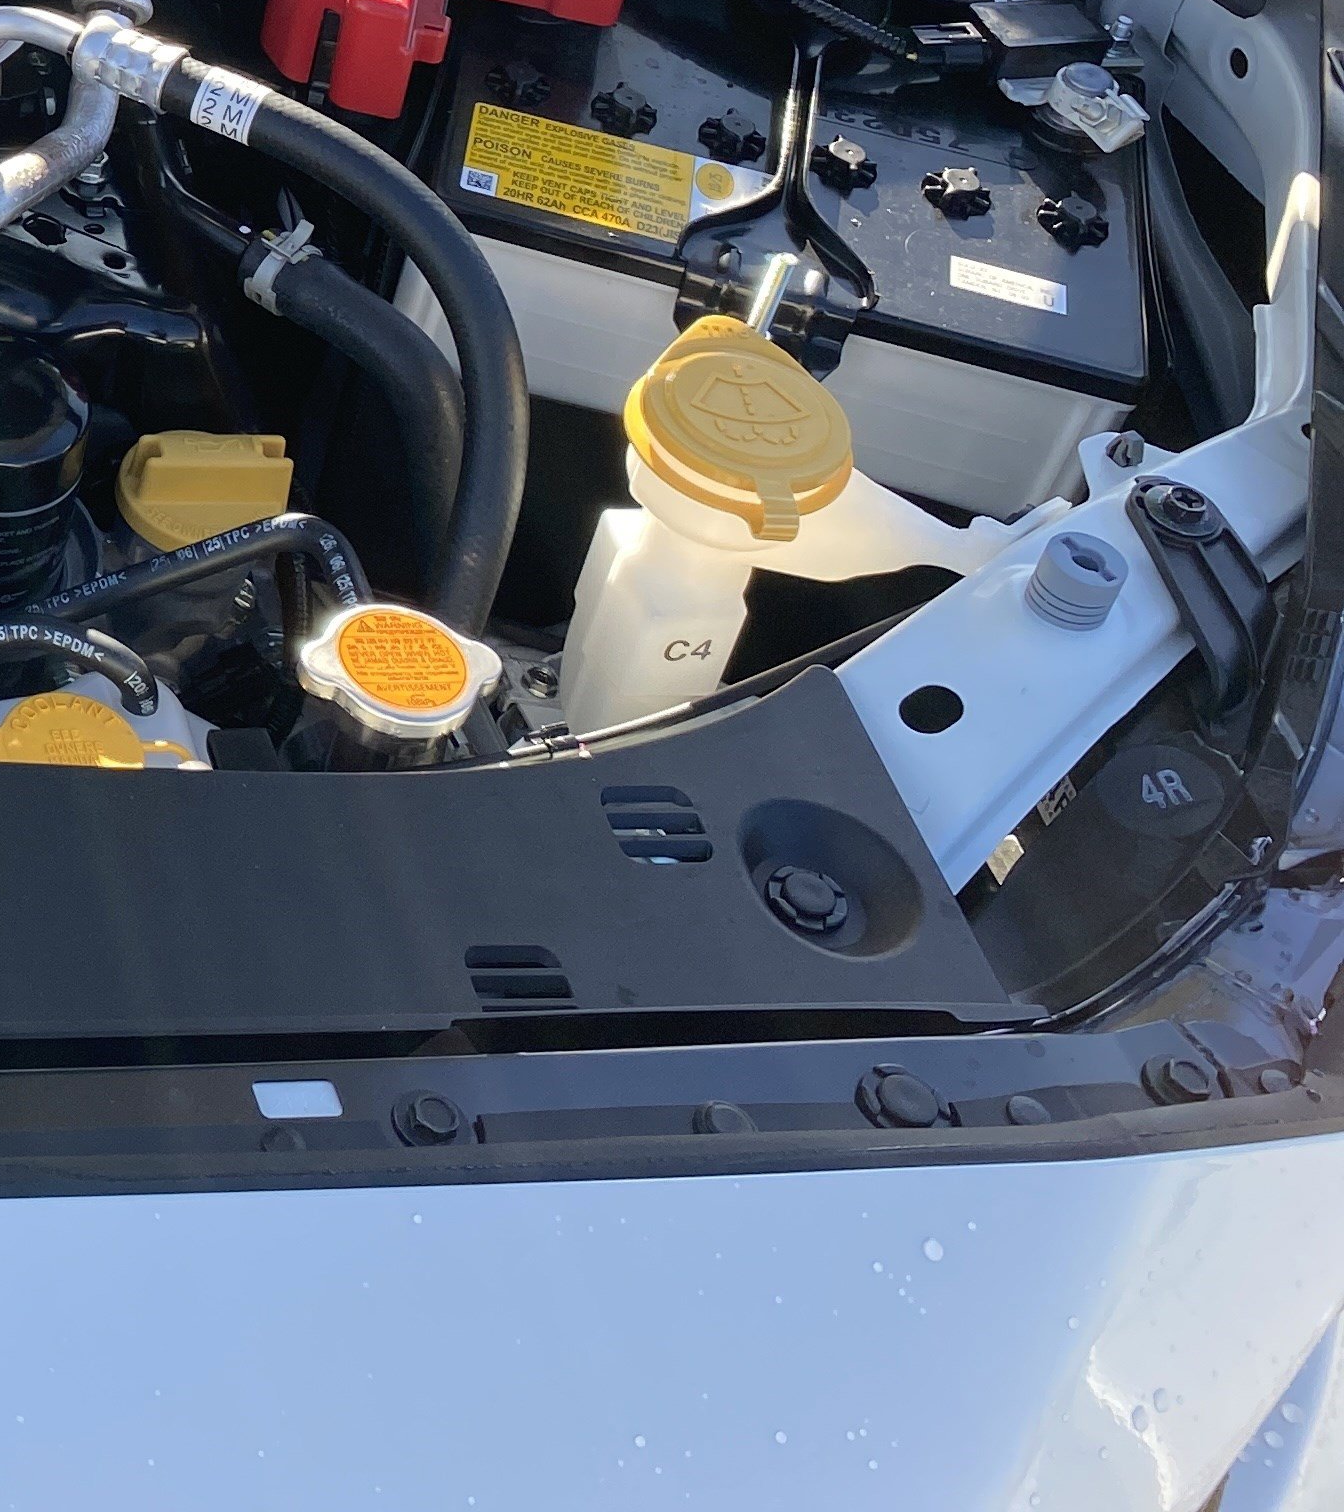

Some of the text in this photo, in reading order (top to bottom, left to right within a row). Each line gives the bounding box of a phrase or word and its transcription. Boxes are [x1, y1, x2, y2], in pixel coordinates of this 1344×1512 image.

[209, 80, 253, 107] 2 M
[202, 97, 244, 126] 2 M
[478, 105, 636, 152] DANGER EXPLOSIVE GASES
[473, 136, 660, 192] POISON CAUSES SEVERE BURNS
[503, 187, 534, 203] 20HR
[537, 195, 566, 212] 62Ah
[572, 204, 599, 220] CCA
[601, 213, 632, 228] 470A
[511, 179, 538, 191] KEEP
[540, 186, 562, 198] OUT
[563, 192, 578, 201] OF
[579, 196, 614, 212] REACH
[616, 205, 631, 215] OF
[512, 170, 540, 182] KEEP
[541, 178, 568, 192] VENT
[569, 184, 597, 199] CAPS
[631, 201, 652, 213] AND
[654, 207, 687, 222] LEVEL
[225, 527, 251, 546] TPC
[46, 592, 70, 611] TPC
[10, 624, 39, 641] TPC
[374, 621, 424, 630] WARNING
[663, 638, 713, 662] C4
[10, 694, 123, 732] COOLANT
[1141, 768, 1194, 809] 4R
